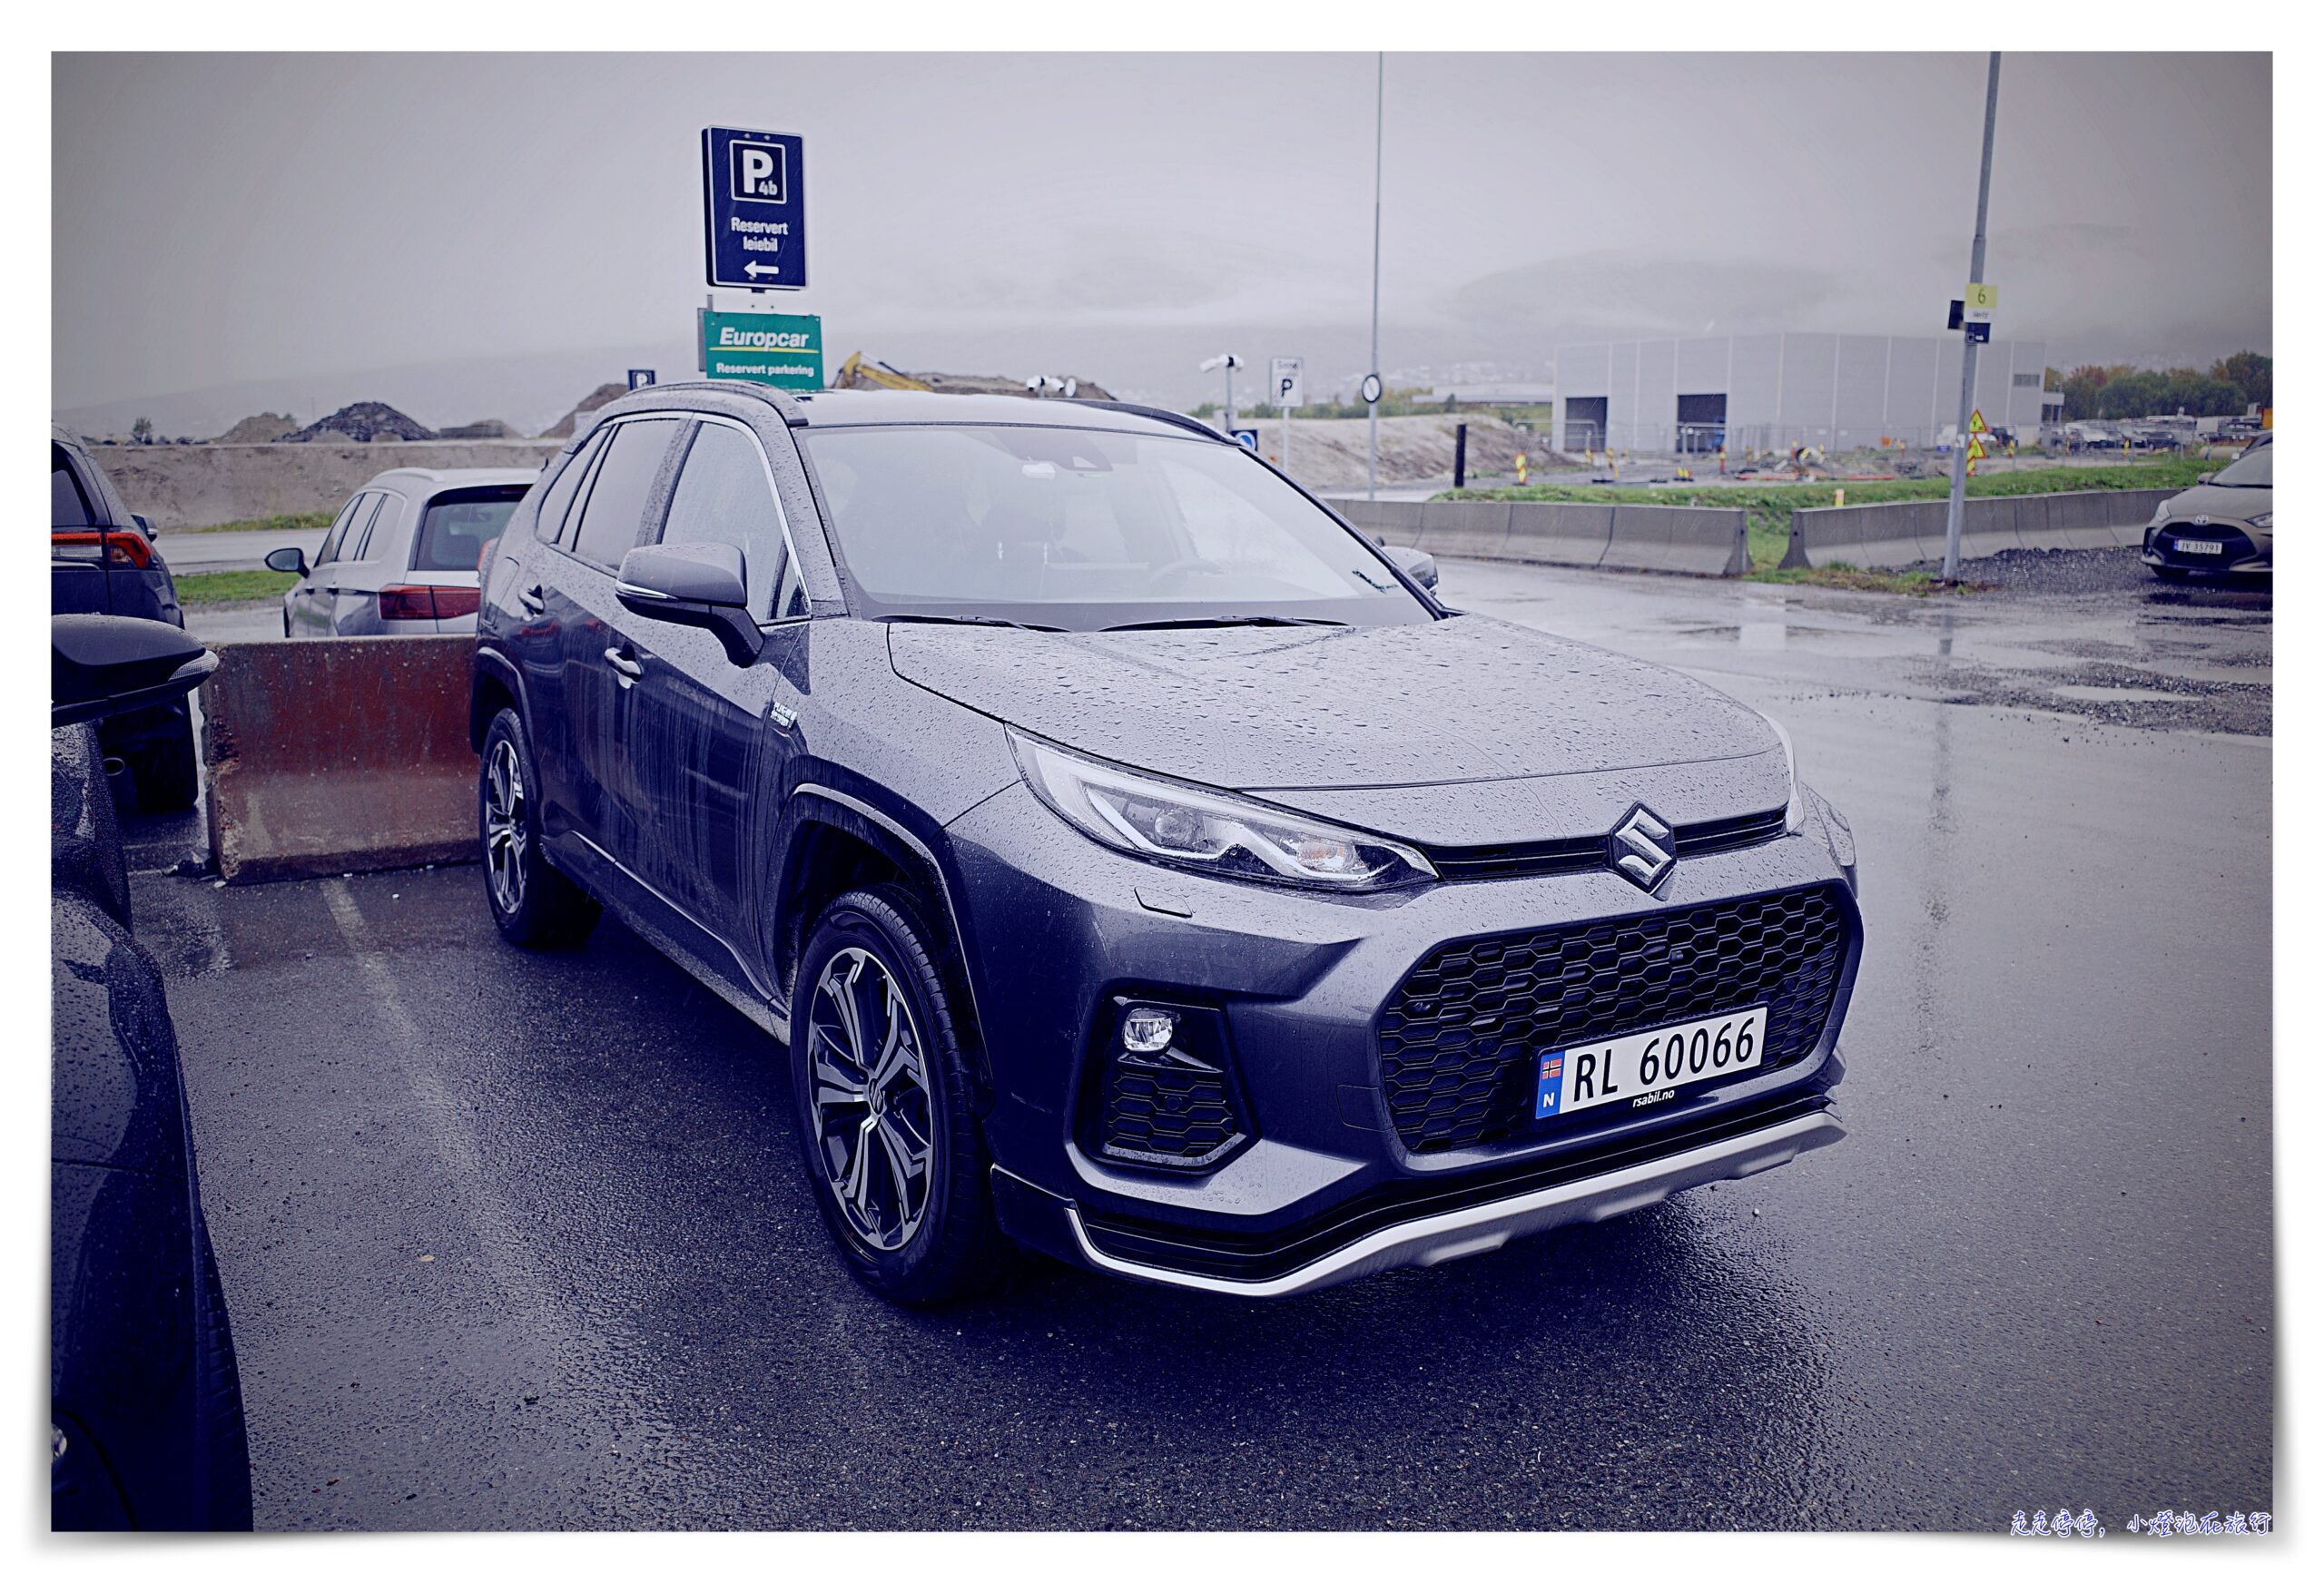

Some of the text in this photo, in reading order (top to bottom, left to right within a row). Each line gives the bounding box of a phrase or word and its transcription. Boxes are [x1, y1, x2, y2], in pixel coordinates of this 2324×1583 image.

[742, 149, 778, 196] P 4b
[731, 216, 789, 236] Reservert
[743, 236, 778, 252] leiebil
[1977, 288, 1986, 305] 6
[720, 326, 809, 352] Europcar
[715, 362, 814, 378] Reservert parkering
[636, 372, 648, 388] P
[1281, 379, 1293, 398] P
[1573, 1016, 1755, 1103] RL 60066
[1543, 1092, 1555, 1108] N
[1632, 1089, 1675, 1108] rsabil.no
